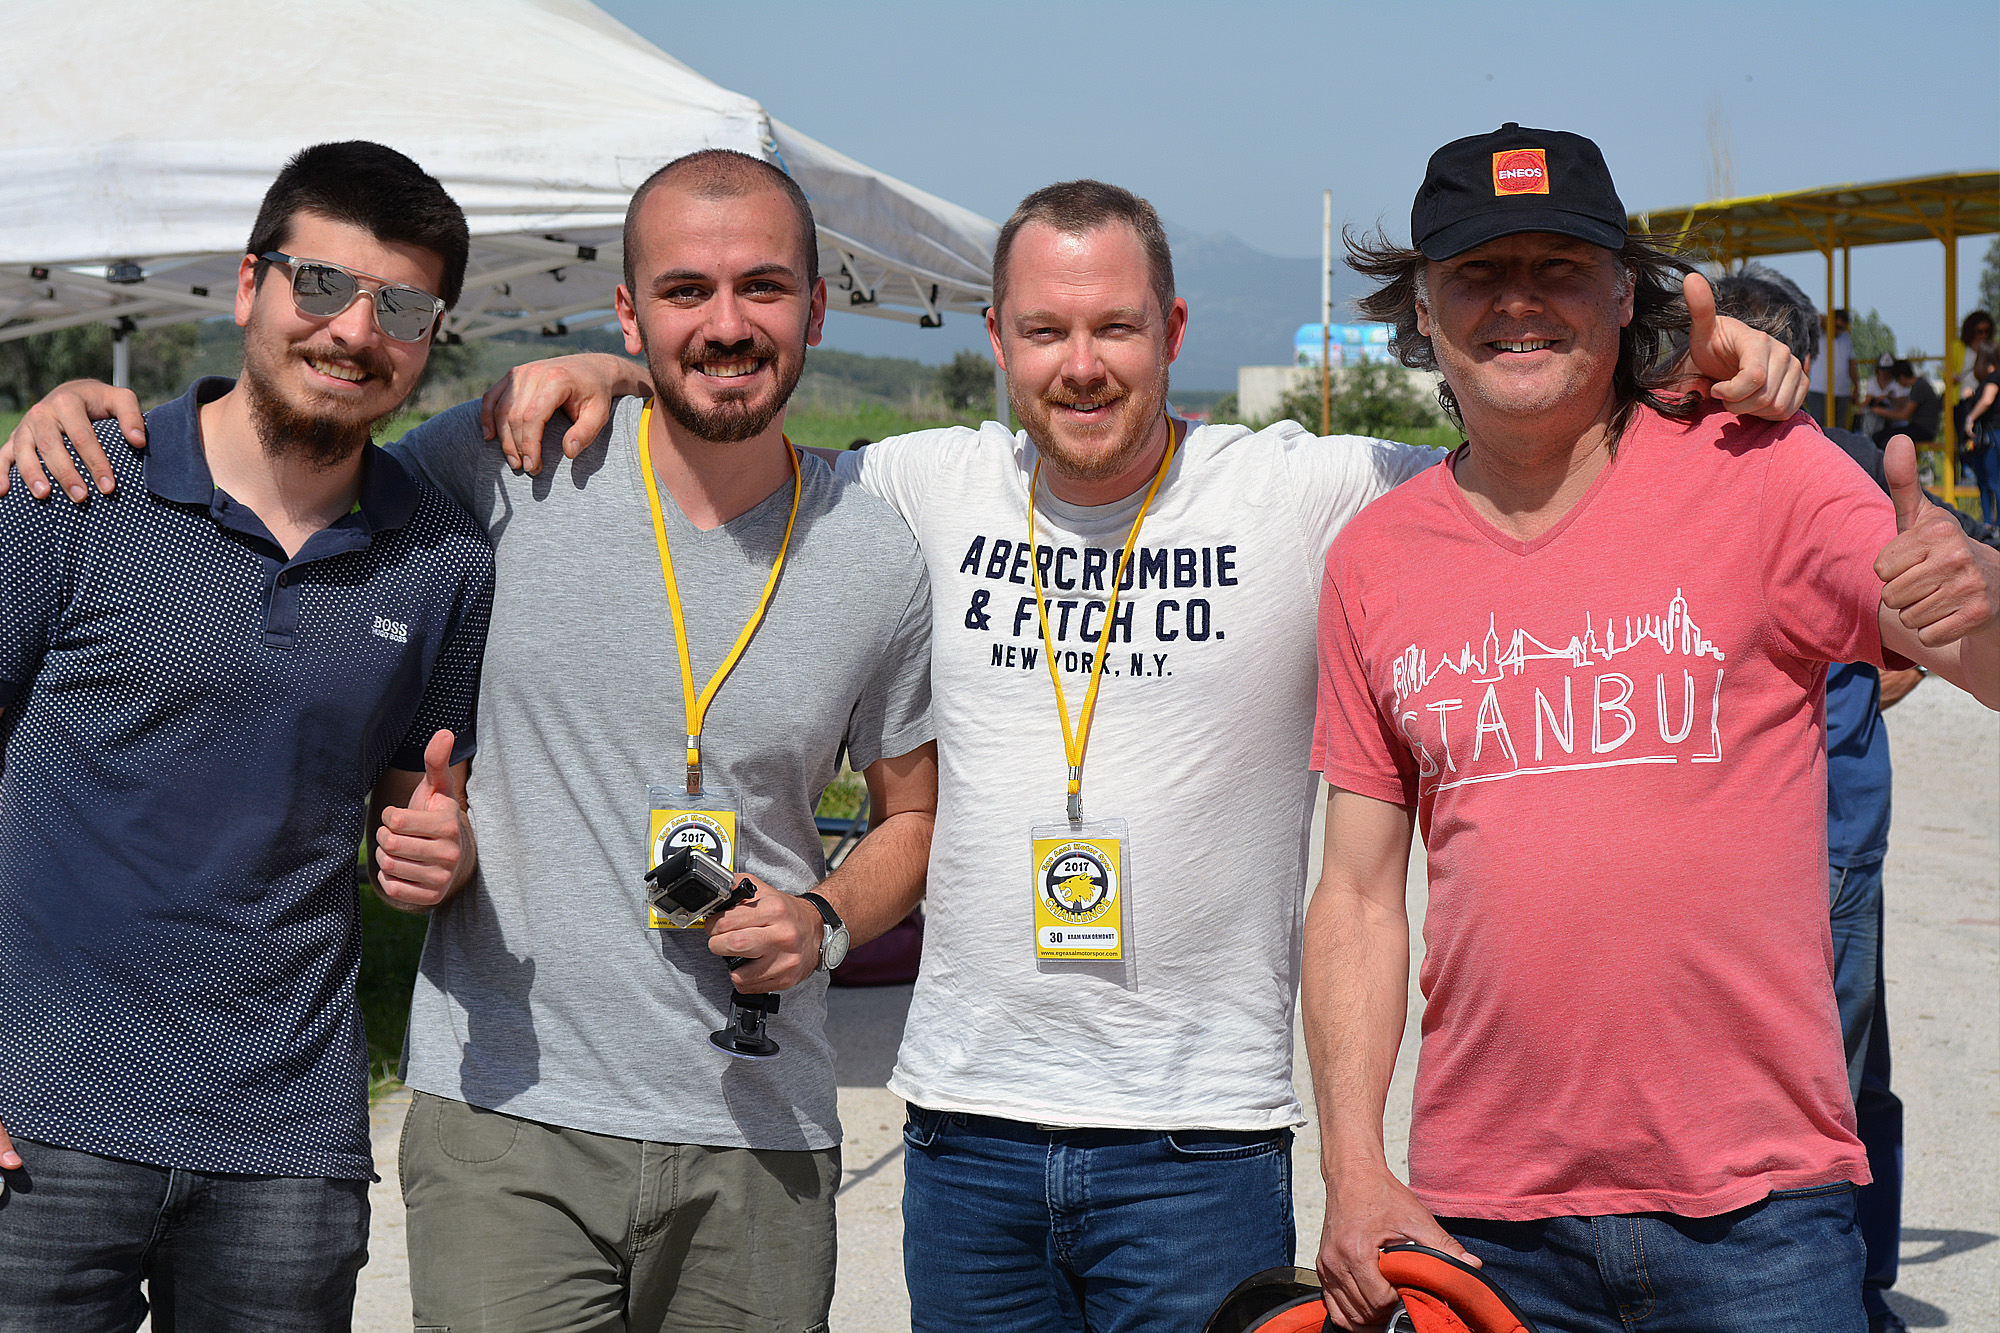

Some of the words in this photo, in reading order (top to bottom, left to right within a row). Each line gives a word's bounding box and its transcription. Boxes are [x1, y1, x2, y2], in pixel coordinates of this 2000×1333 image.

[1498, 168, 1543, 180] ENEOS
[960, 535, 1239, 591] ABERCROMBIE
[964, 588, 992, 631] &
[1012, 596, 1135, 643] FITCH
[1155, 598, 1225, 642] CO.
[372, 615, 408, 637] BOSS
[389, 633, 408, 644] BOSS
[990, 643, 1038, 671] NEW
[1052, 650, 1121, 678] YORK,
[1130, 652, 1173, 677] N.Y.
[690, 814, 715, 827] Motor
[681, 832, 706, 843] 2017
[1073, 843, 1098, 855] Motor
[1064, 861, 1090, 872] 2017
[1045, 897, 1112, 923] CHALLENGE
[1049, 931, 1063, 943] 30
